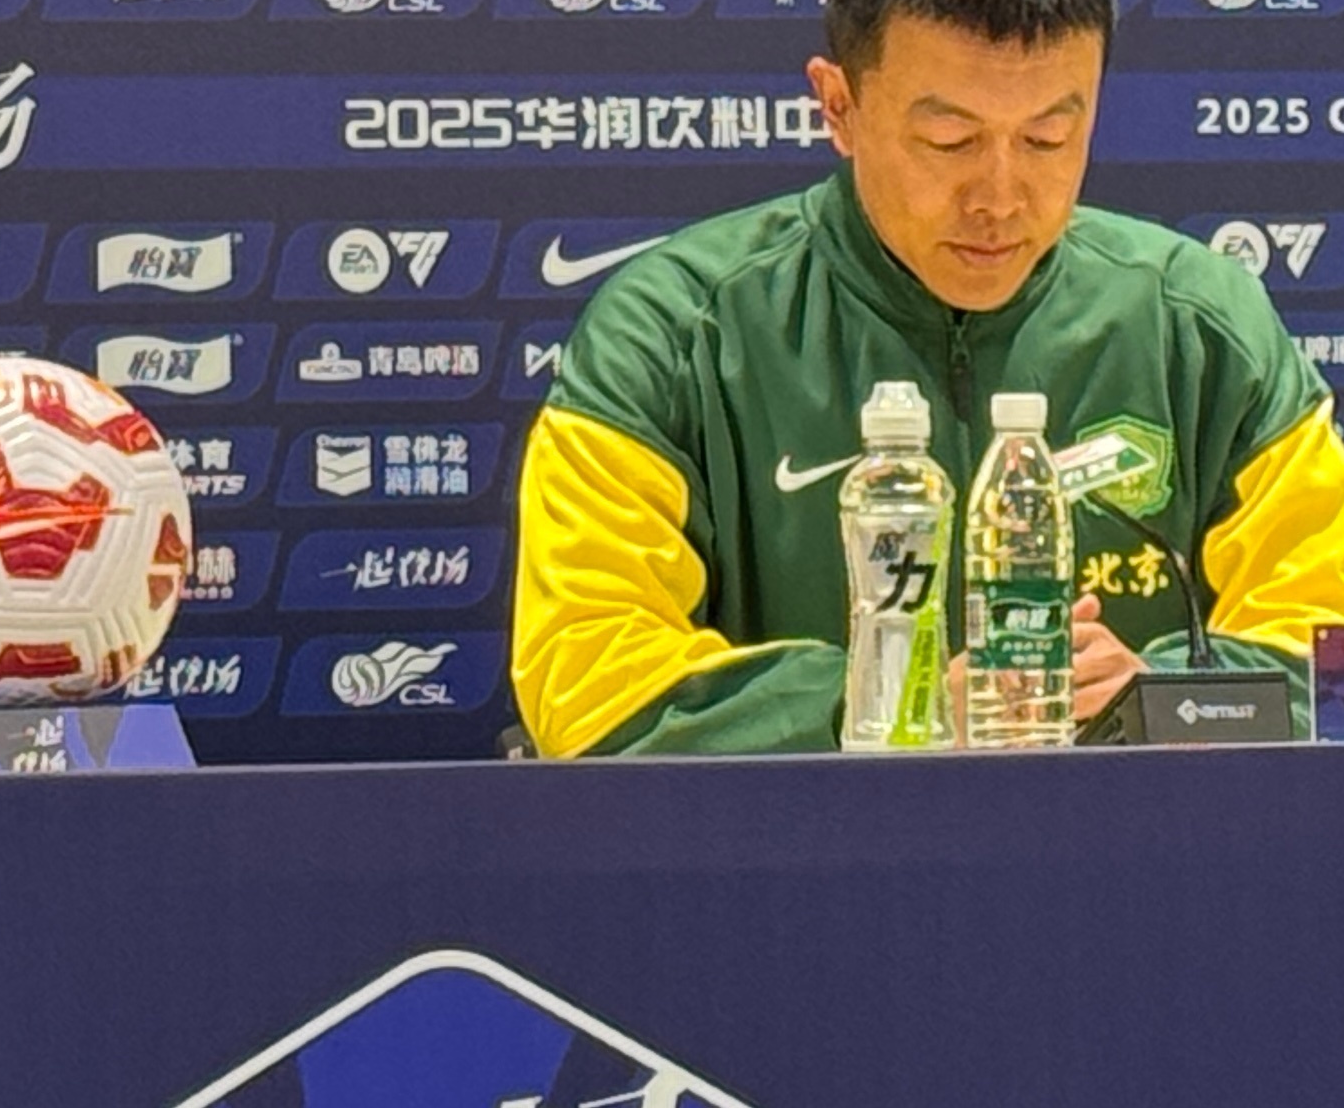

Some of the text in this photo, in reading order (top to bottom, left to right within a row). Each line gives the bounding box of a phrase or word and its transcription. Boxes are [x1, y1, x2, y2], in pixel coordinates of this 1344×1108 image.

[1198, 99, 1308, 133] 2025
[1081, 543, 1170, 600] 北京
[401, 683, 453, 704] CSL
